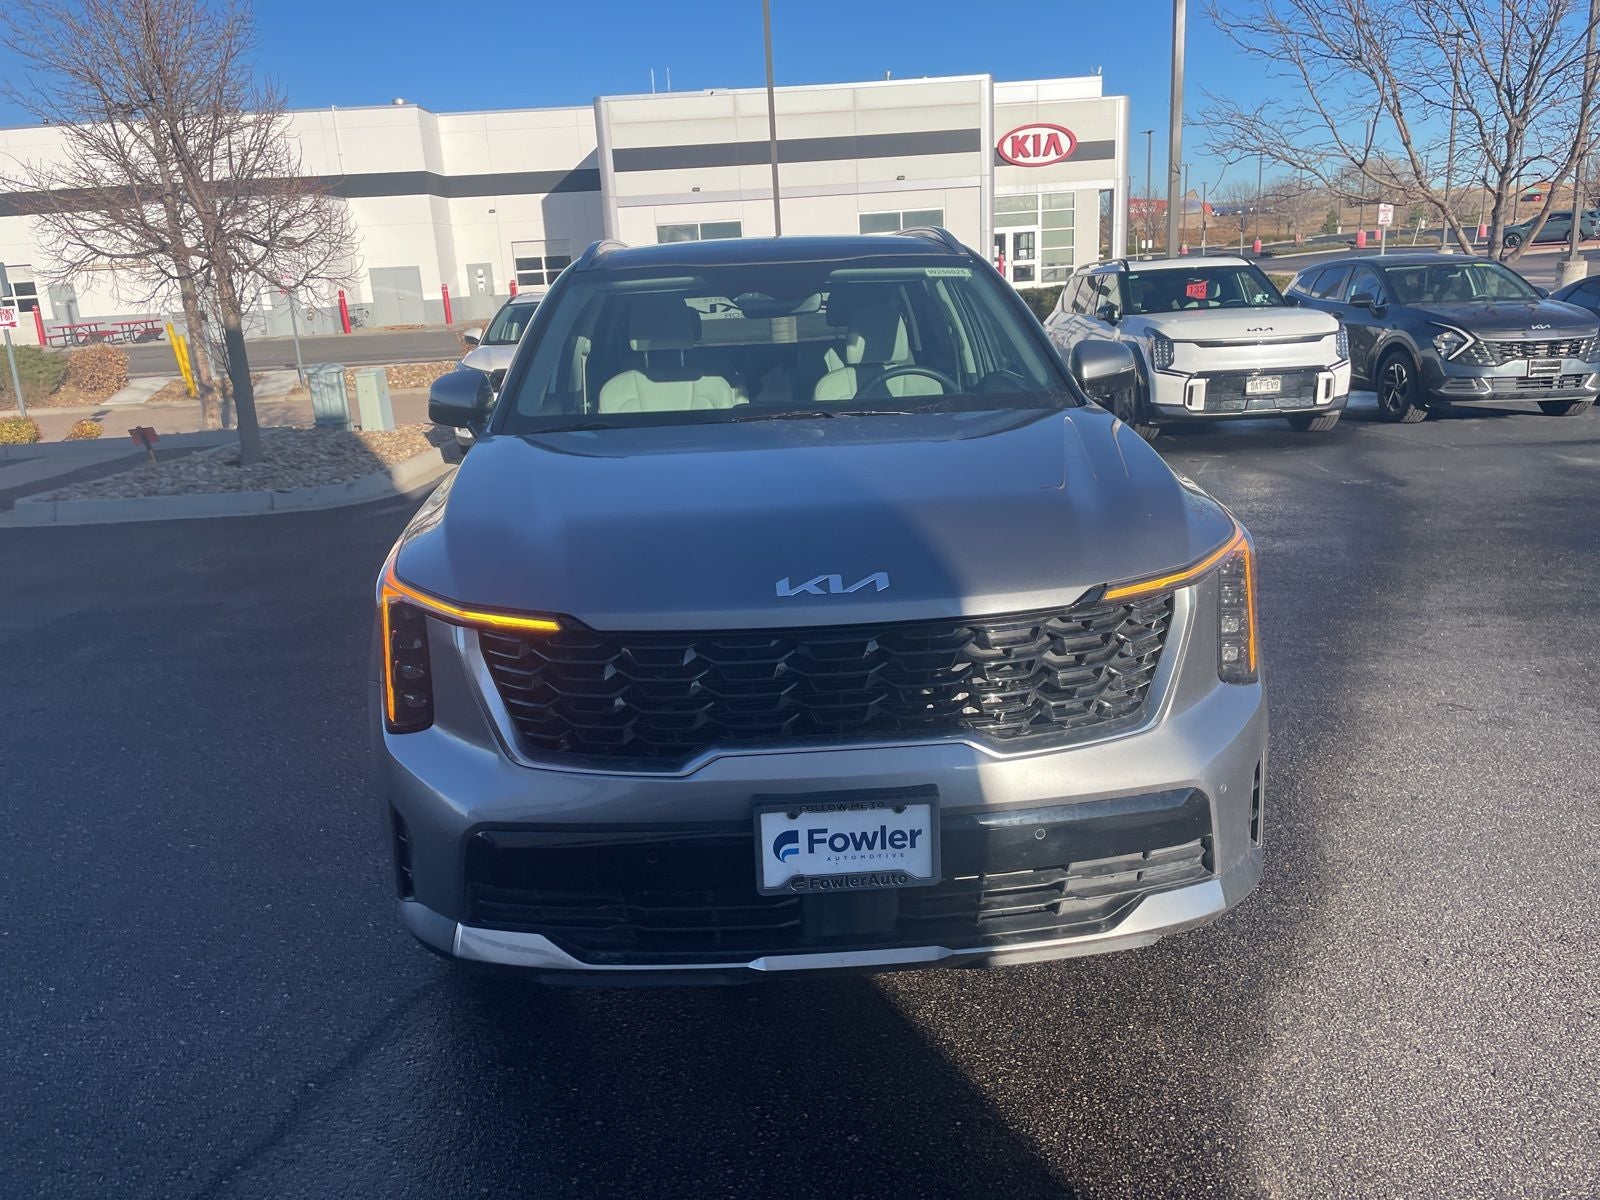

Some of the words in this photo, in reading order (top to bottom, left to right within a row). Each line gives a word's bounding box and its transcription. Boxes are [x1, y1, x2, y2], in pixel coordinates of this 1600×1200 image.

[1010, 133, 1063, 158] KIA
[776, 571, 890, 597] KIA
[800, 803, 848, 813] FOLLOW
[851, 802, 868, 811] ME
[807, 825, 922, 854] Fowler
[826, 852, 905, 862] AUTOMOTIVE
[809, 873, 908, 891] FowlerAuto
